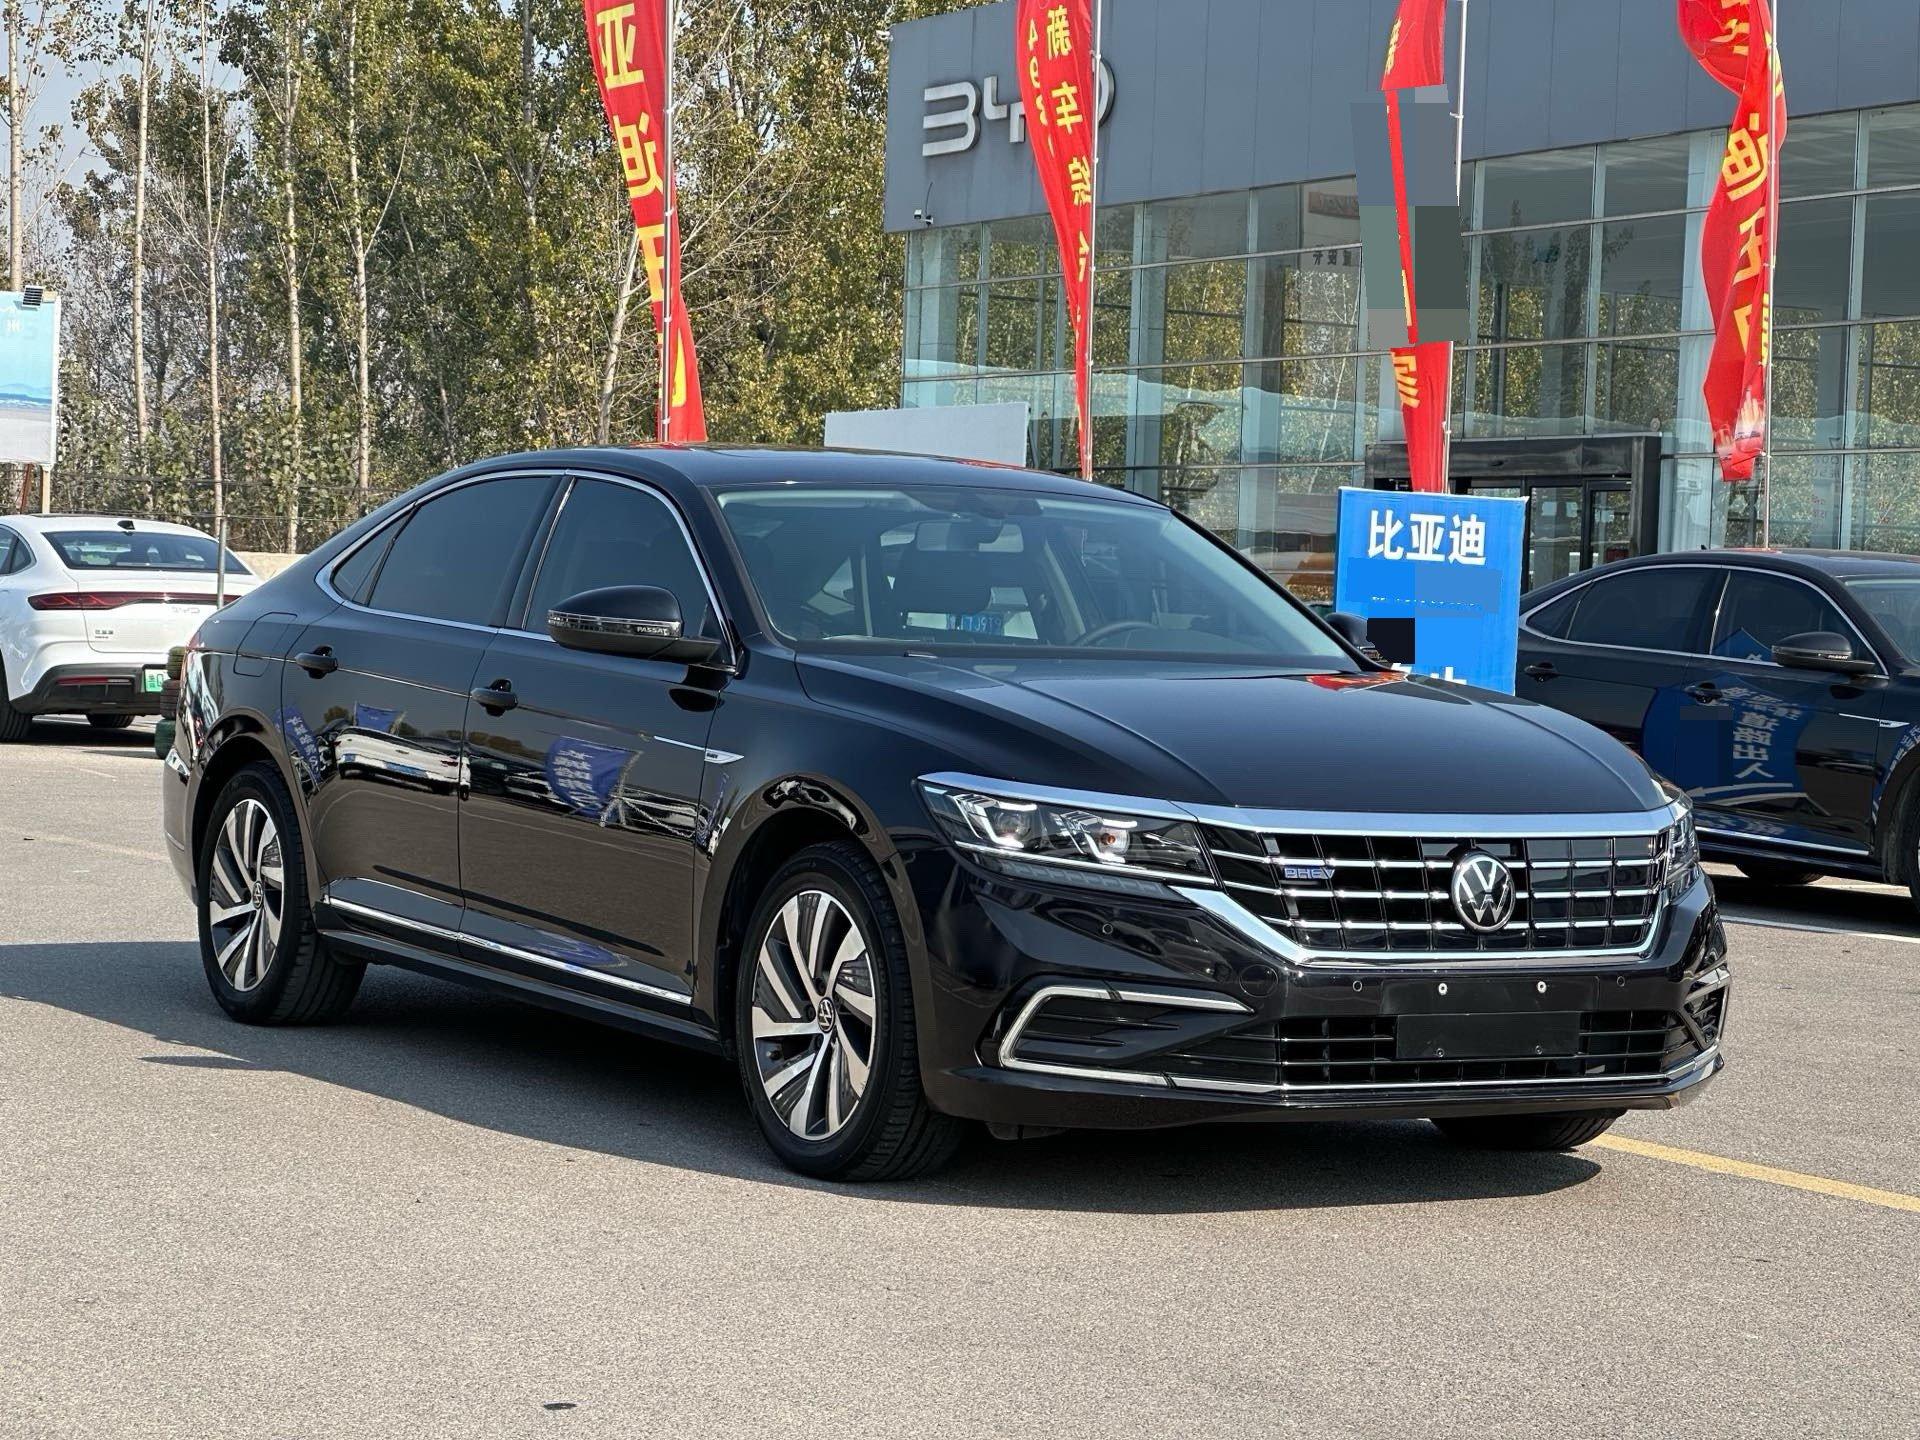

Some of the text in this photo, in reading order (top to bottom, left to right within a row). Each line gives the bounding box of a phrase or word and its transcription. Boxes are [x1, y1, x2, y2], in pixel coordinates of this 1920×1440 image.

[1367, 509, 1487, 566] 比亚迪
[1284, 867, 1336, 880] PHEV
